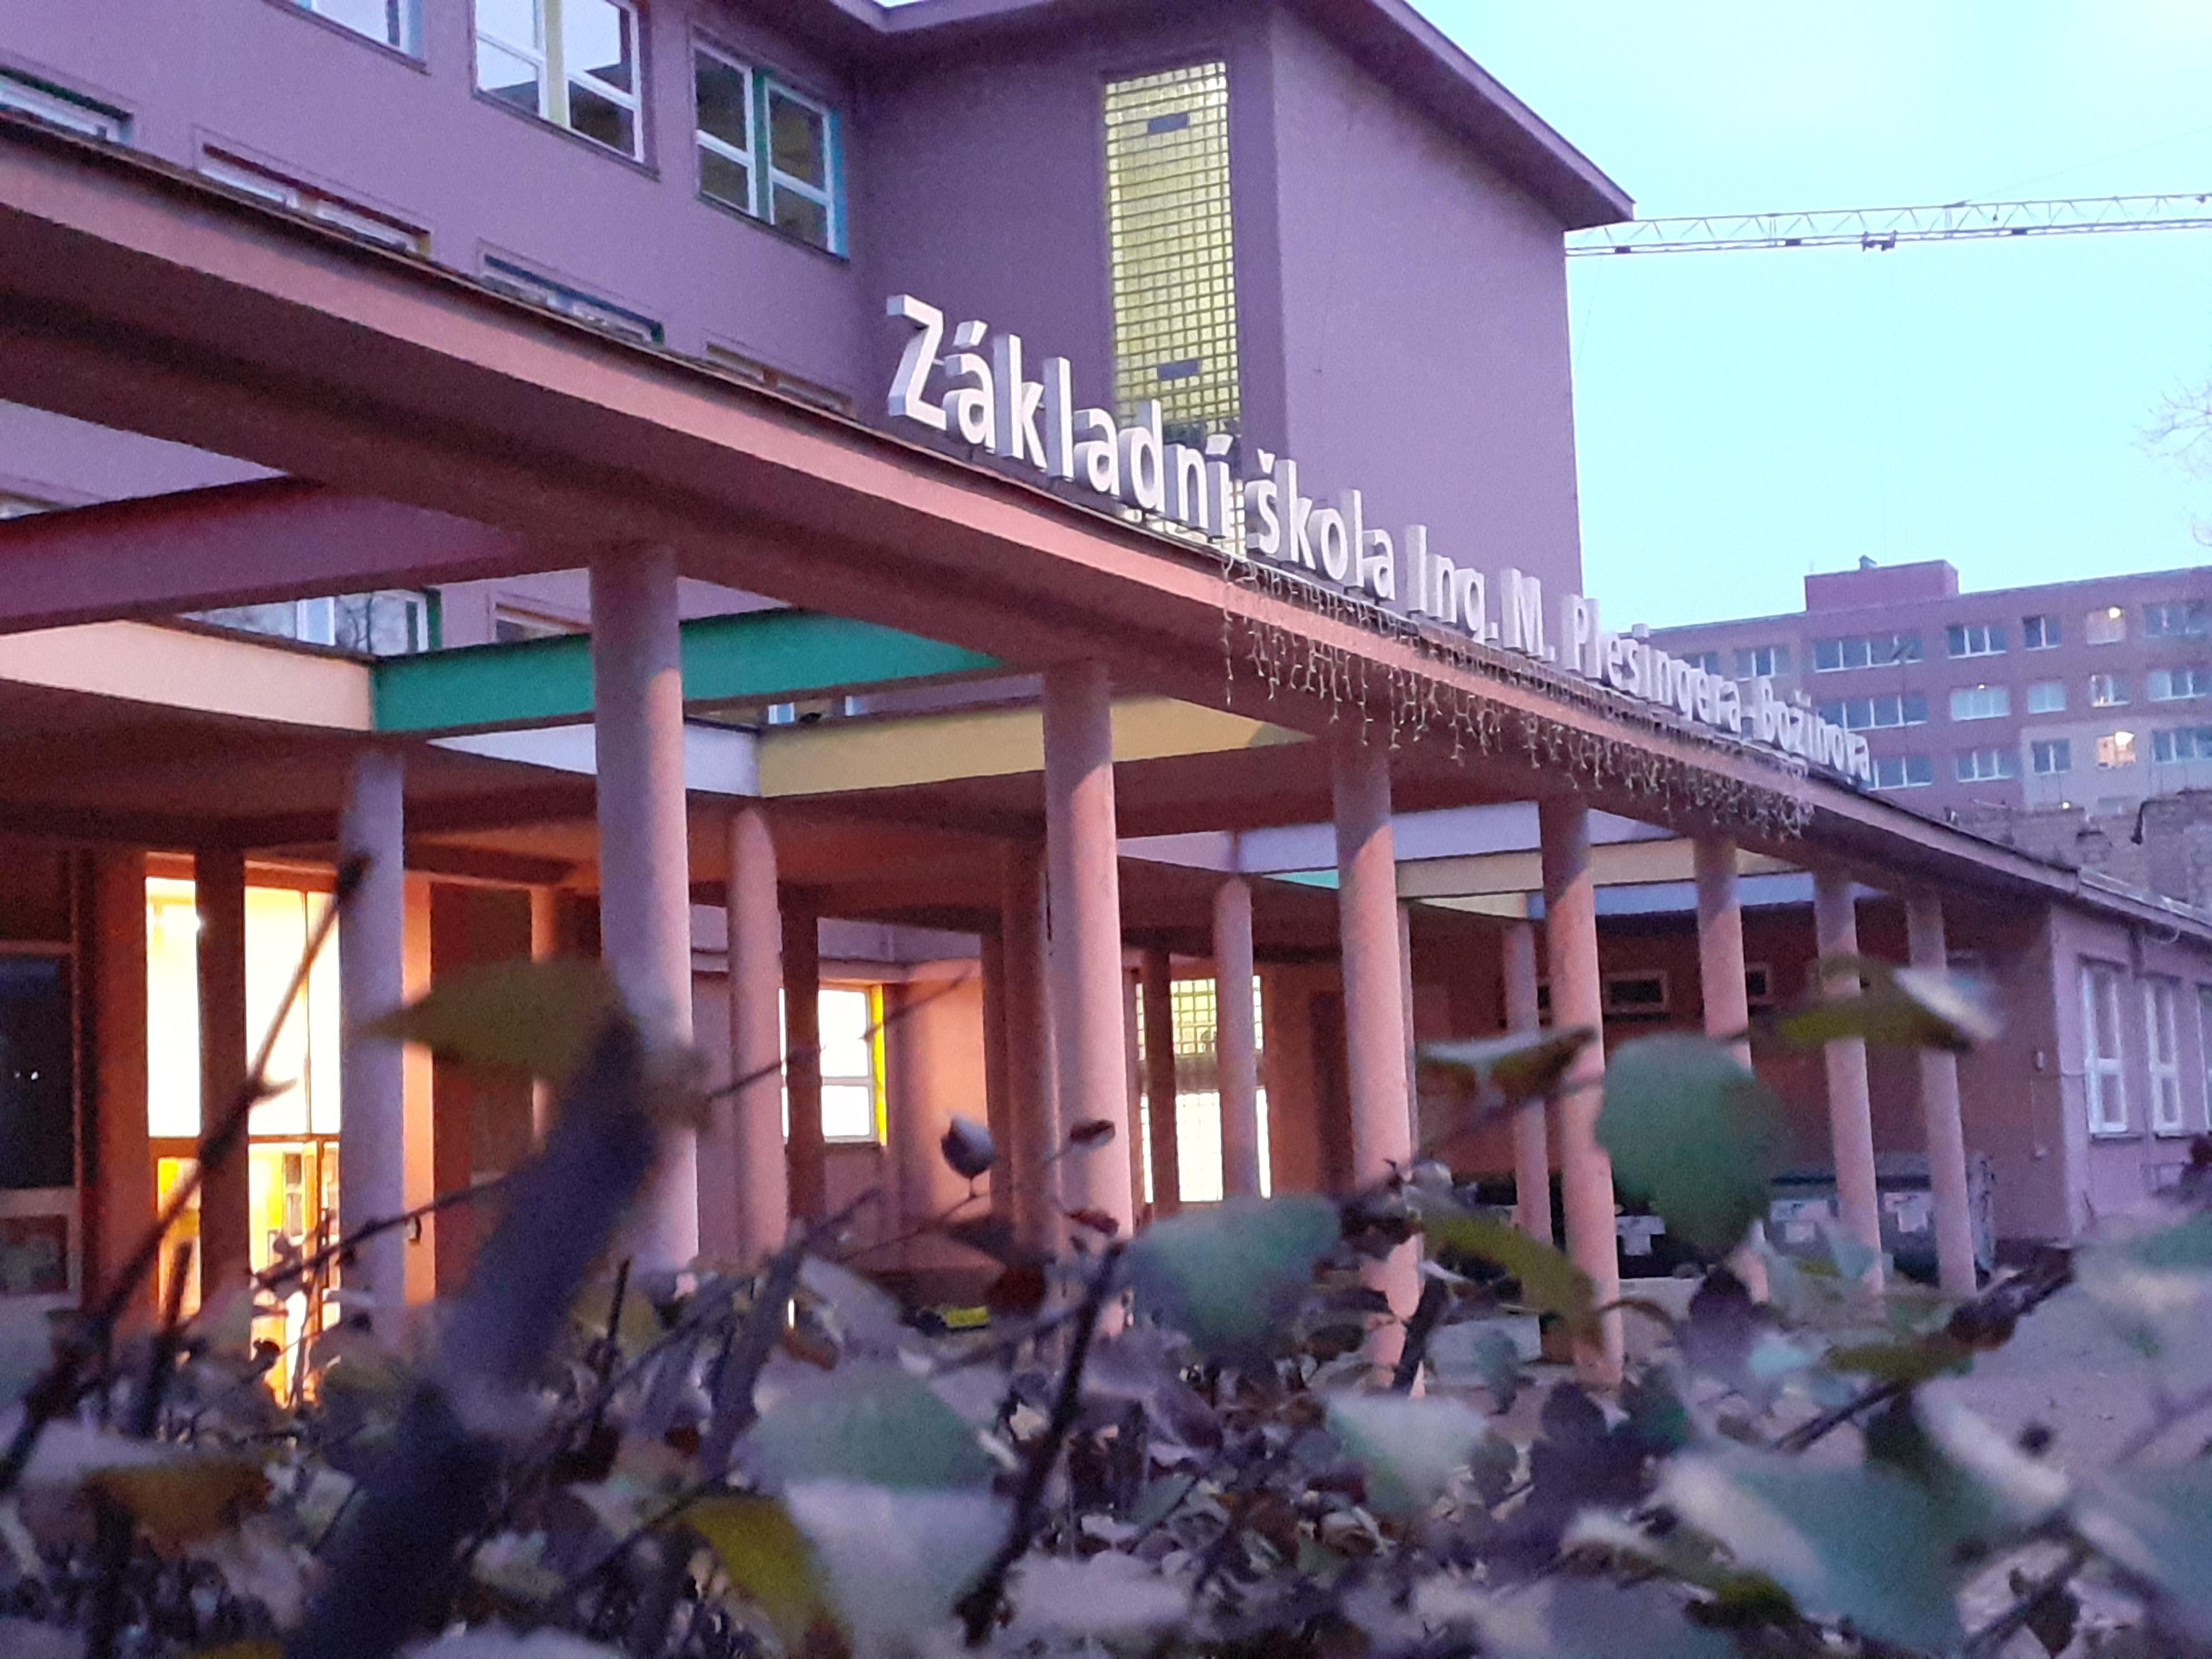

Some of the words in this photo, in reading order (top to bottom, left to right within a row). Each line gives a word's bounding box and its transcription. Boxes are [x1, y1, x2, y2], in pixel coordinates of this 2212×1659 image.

[886, 294, 1232, 538] Základní
[1245, 448, 1395, 601] škola
[1406, 525, 1498, 645] Ing.
[1500, 568, 1554, 662] M.
